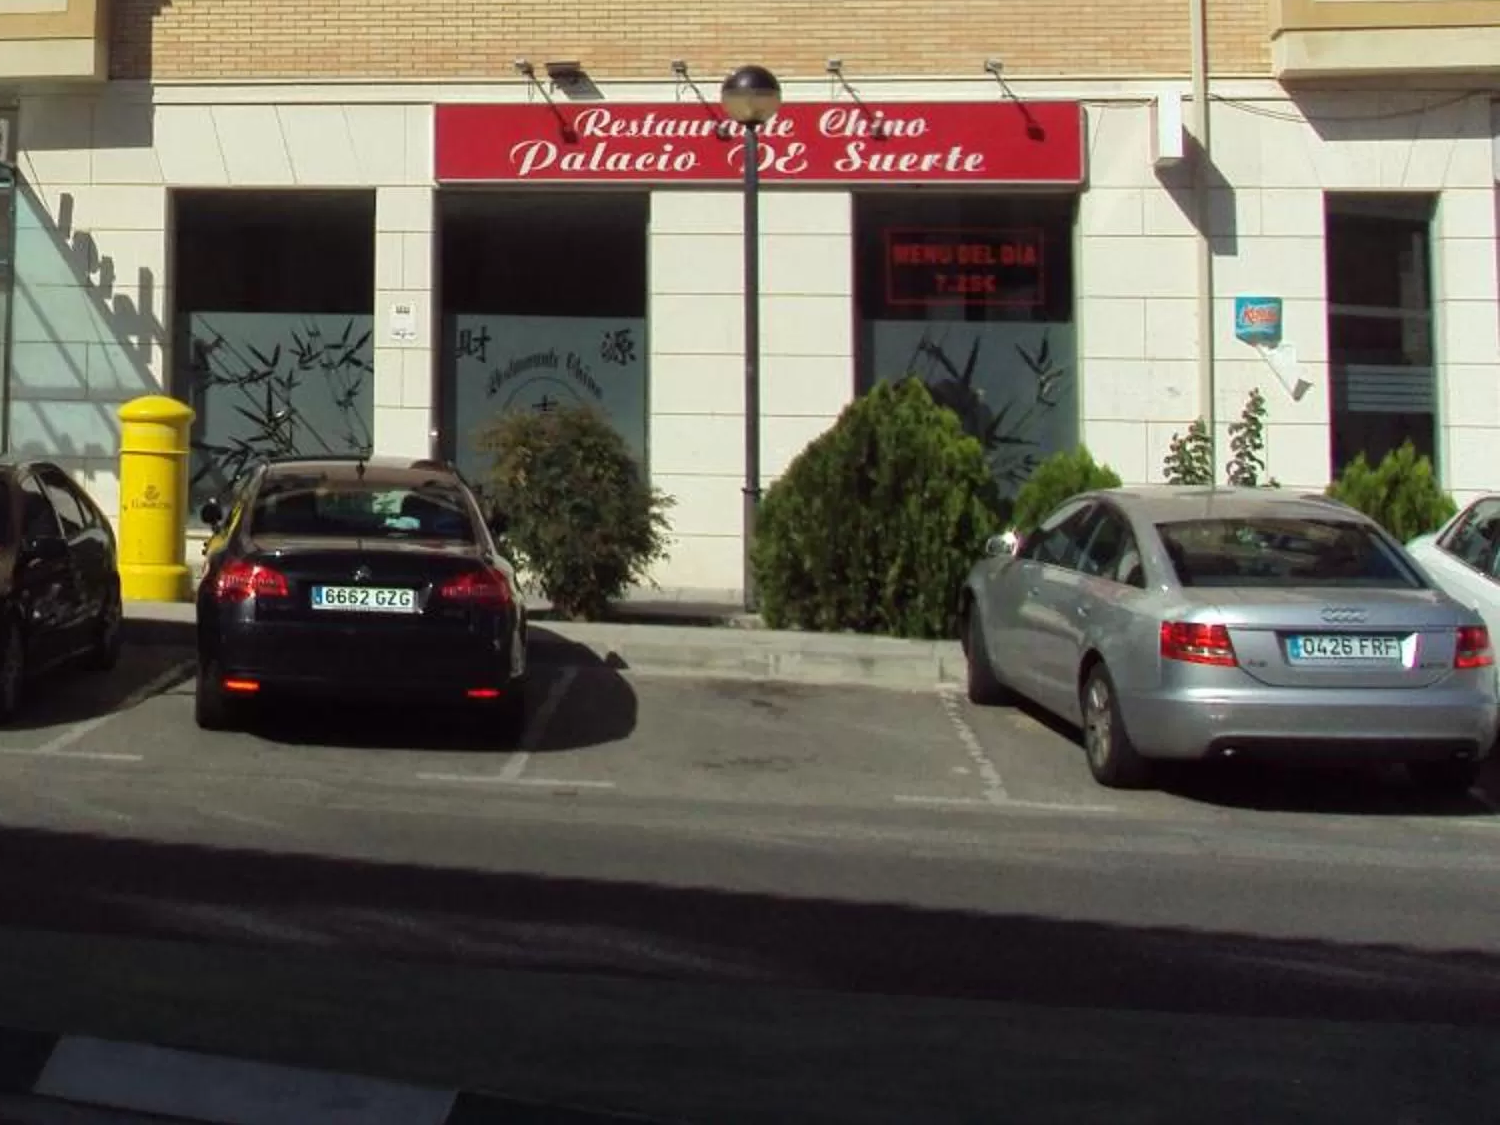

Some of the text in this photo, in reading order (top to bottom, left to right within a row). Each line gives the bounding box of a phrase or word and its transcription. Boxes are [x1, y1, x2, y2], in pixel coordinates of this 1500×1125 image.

[574, 108, 929, 138] Restaurate Chino
[509, 139, 701, 176] Palacio
[834, 141, 986, 173] Suerte
[325, 588, 411, 606] 6662 GZG
[1303, 637, 1397, 657] 0426 FRF
